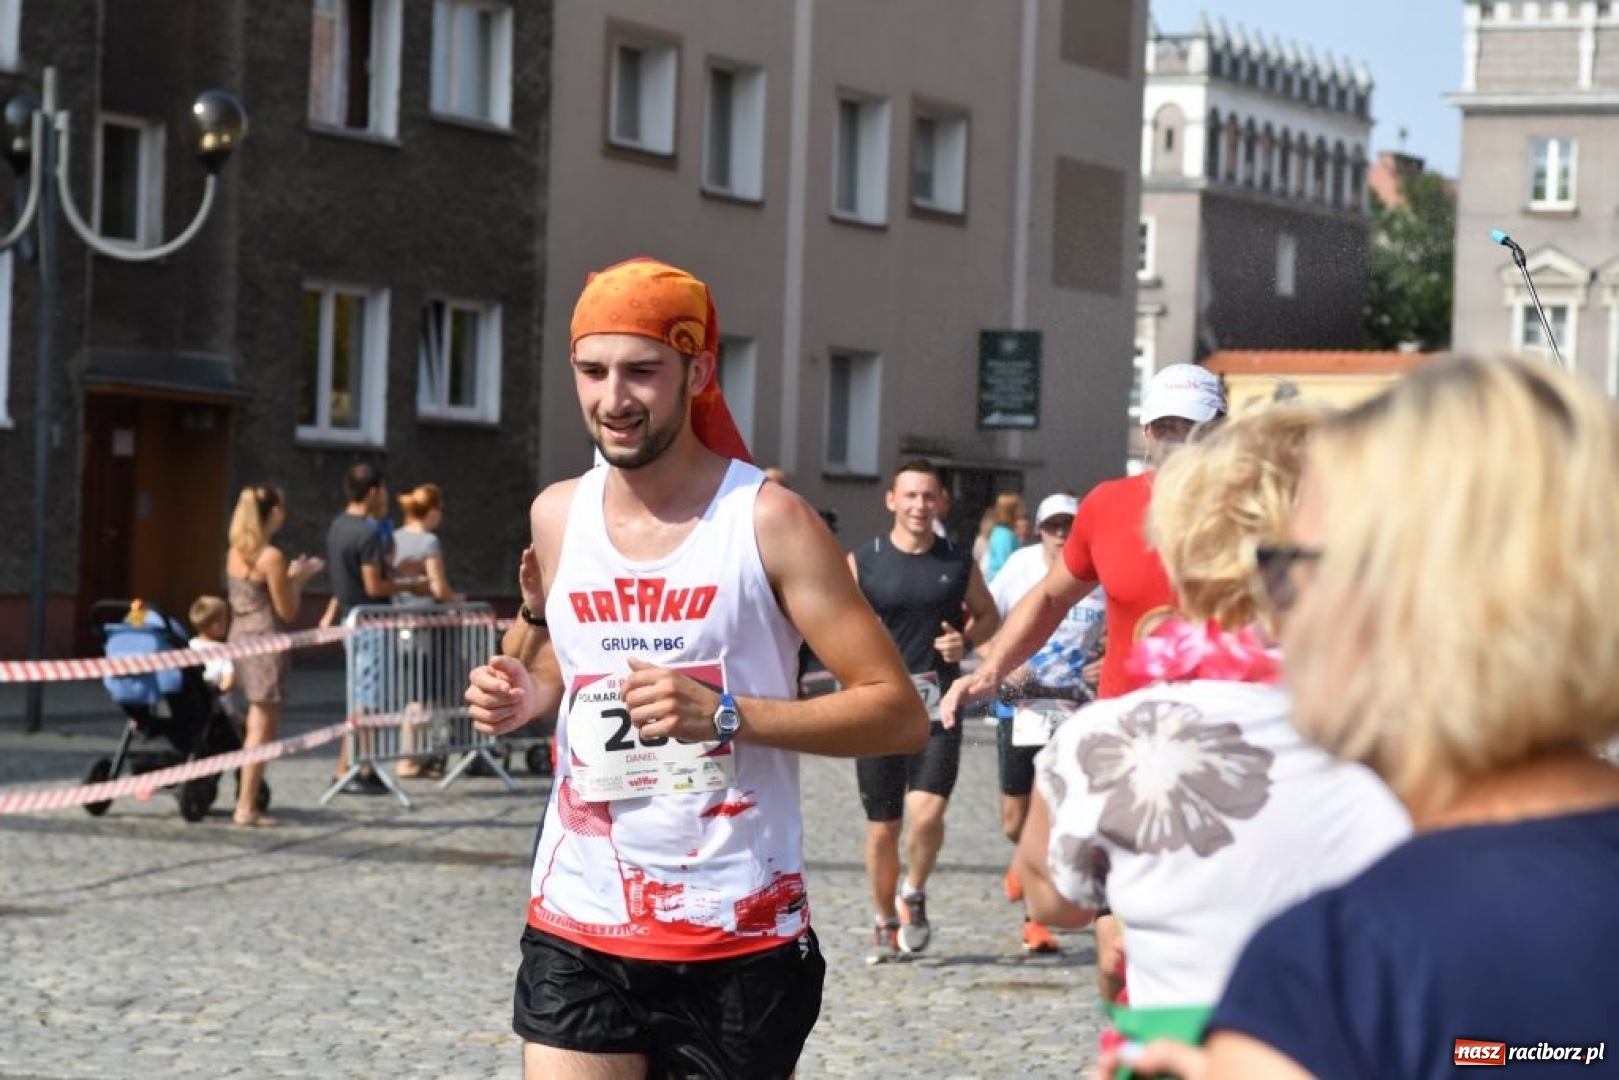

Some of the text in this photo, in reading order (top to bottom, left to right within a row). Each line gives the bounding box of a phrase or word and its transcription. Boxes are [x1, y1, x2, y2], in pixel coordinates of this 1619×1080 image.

[569, 578, 718, 623] RAFAKO
[602, 637, 684, 650] GRUPA PBG
[626, 752, 658, 763] DANIEL
